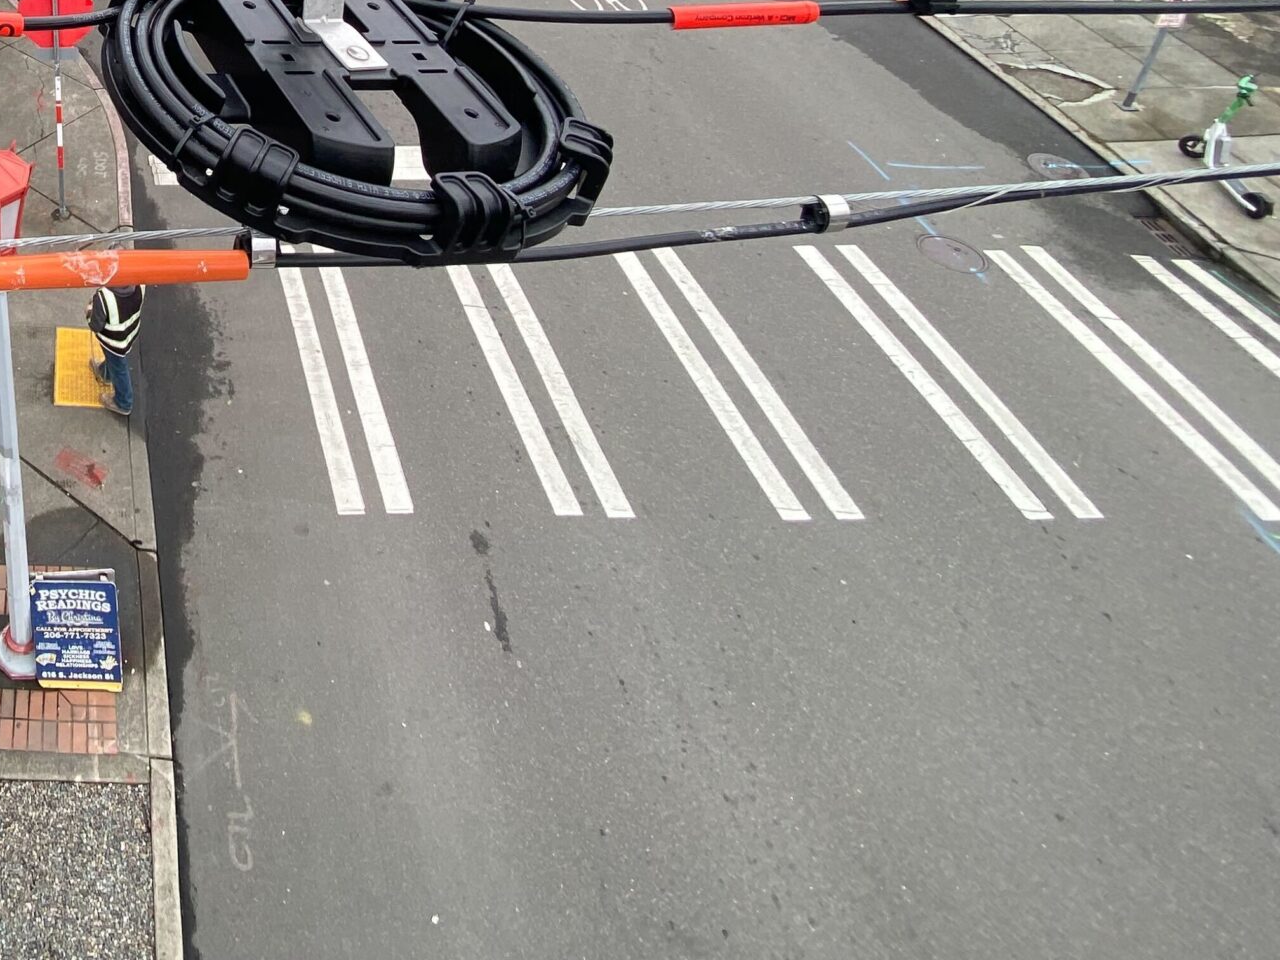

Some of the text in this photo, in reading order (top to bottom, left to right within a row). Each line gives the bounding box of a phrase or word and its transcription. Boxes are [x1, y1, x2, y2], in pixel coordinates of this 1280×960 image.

[38, 589, 107, 601] PSYCHIC
[35, 599, 112, 613] READINGS
[43, 631, 107, 640] 206-771-7323
[68, 672, 103, 680] Jackson
